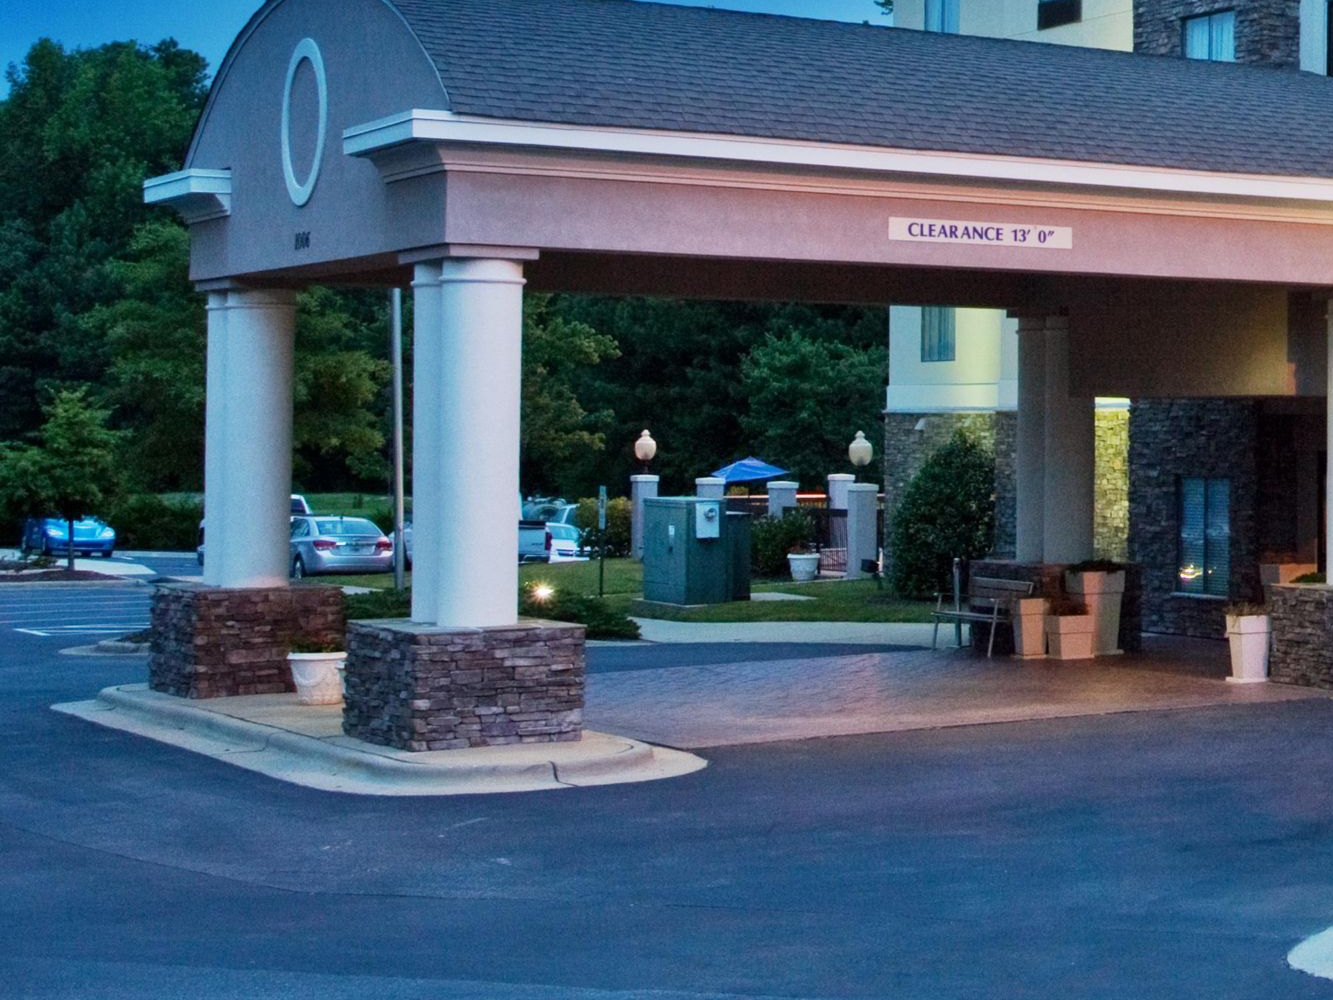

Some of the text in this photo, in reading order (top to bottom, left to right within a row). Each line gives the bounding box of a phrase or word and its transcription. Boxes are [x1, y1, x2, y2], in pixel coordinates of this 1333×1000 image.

[907, 222, 1055, 244] CLEARANCE 13' 0"
